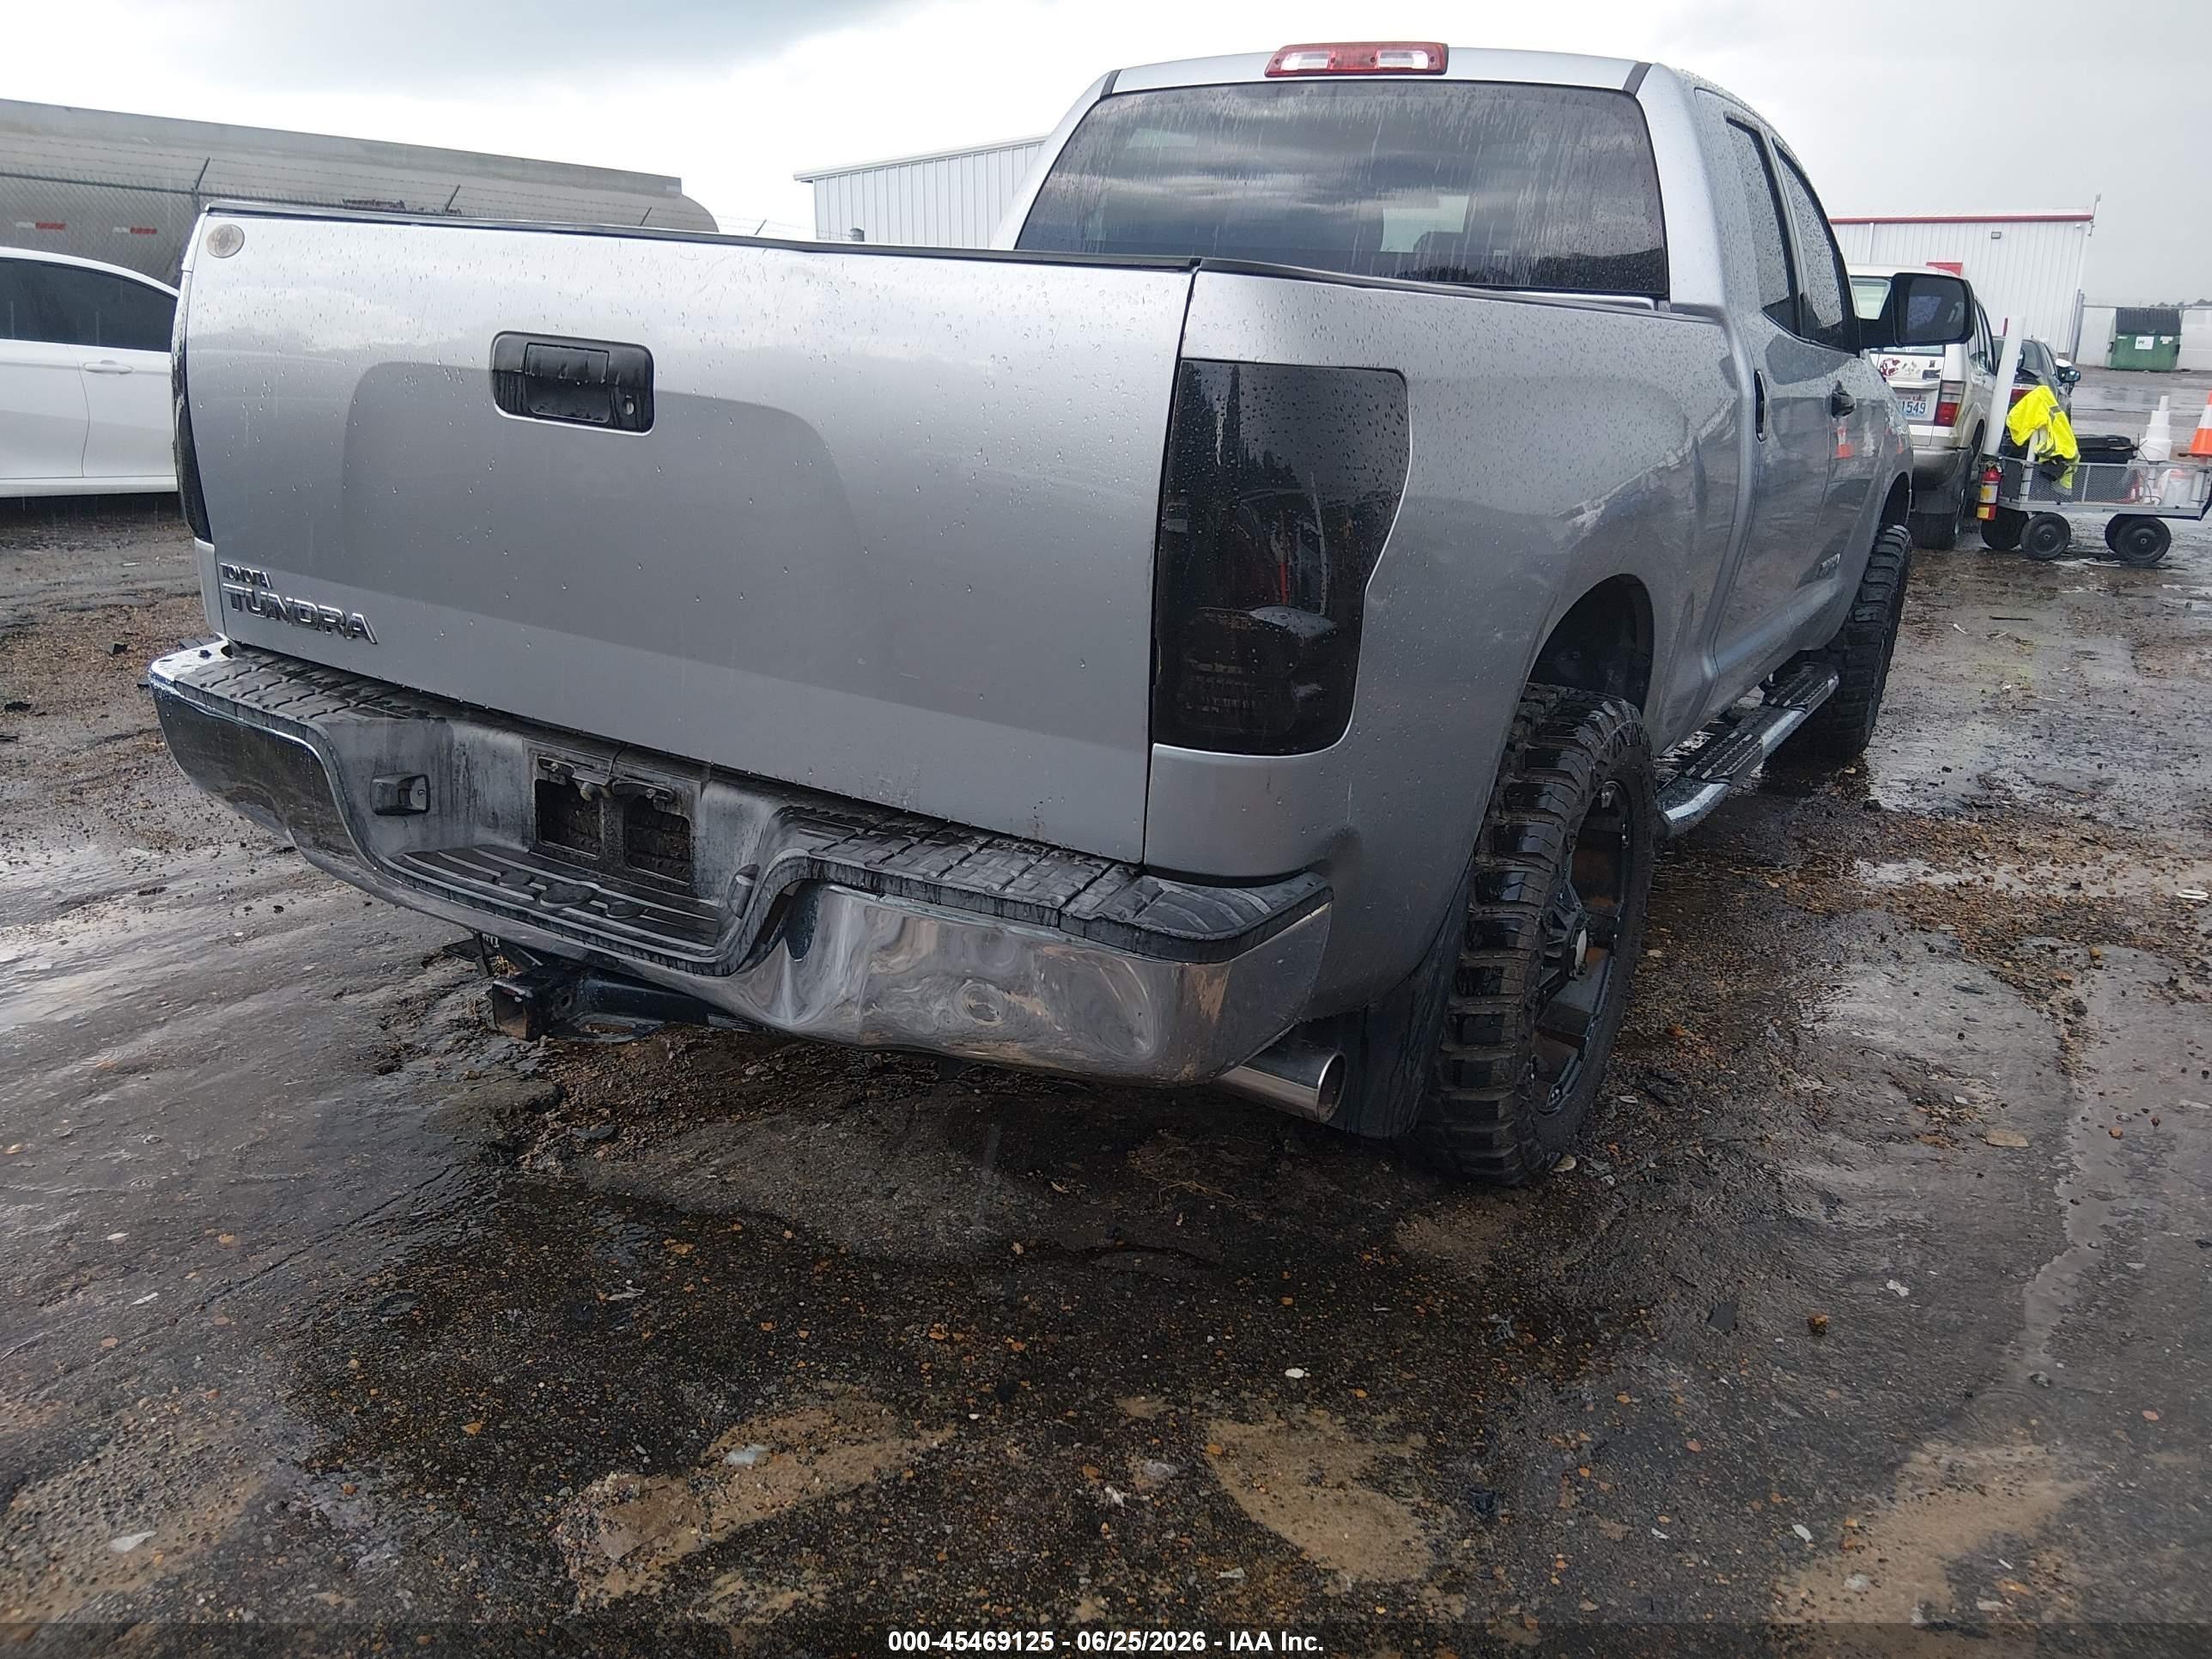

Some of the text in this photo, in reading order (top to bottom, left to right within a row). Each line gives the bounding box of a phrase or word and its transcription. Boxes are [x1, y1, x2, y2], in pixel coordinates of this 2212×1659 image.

[1902, 401, 1926, 414] 1549
[219, 562, 273, 590] TOYOTA
[222, 582, 379, 645] TUNDRA
